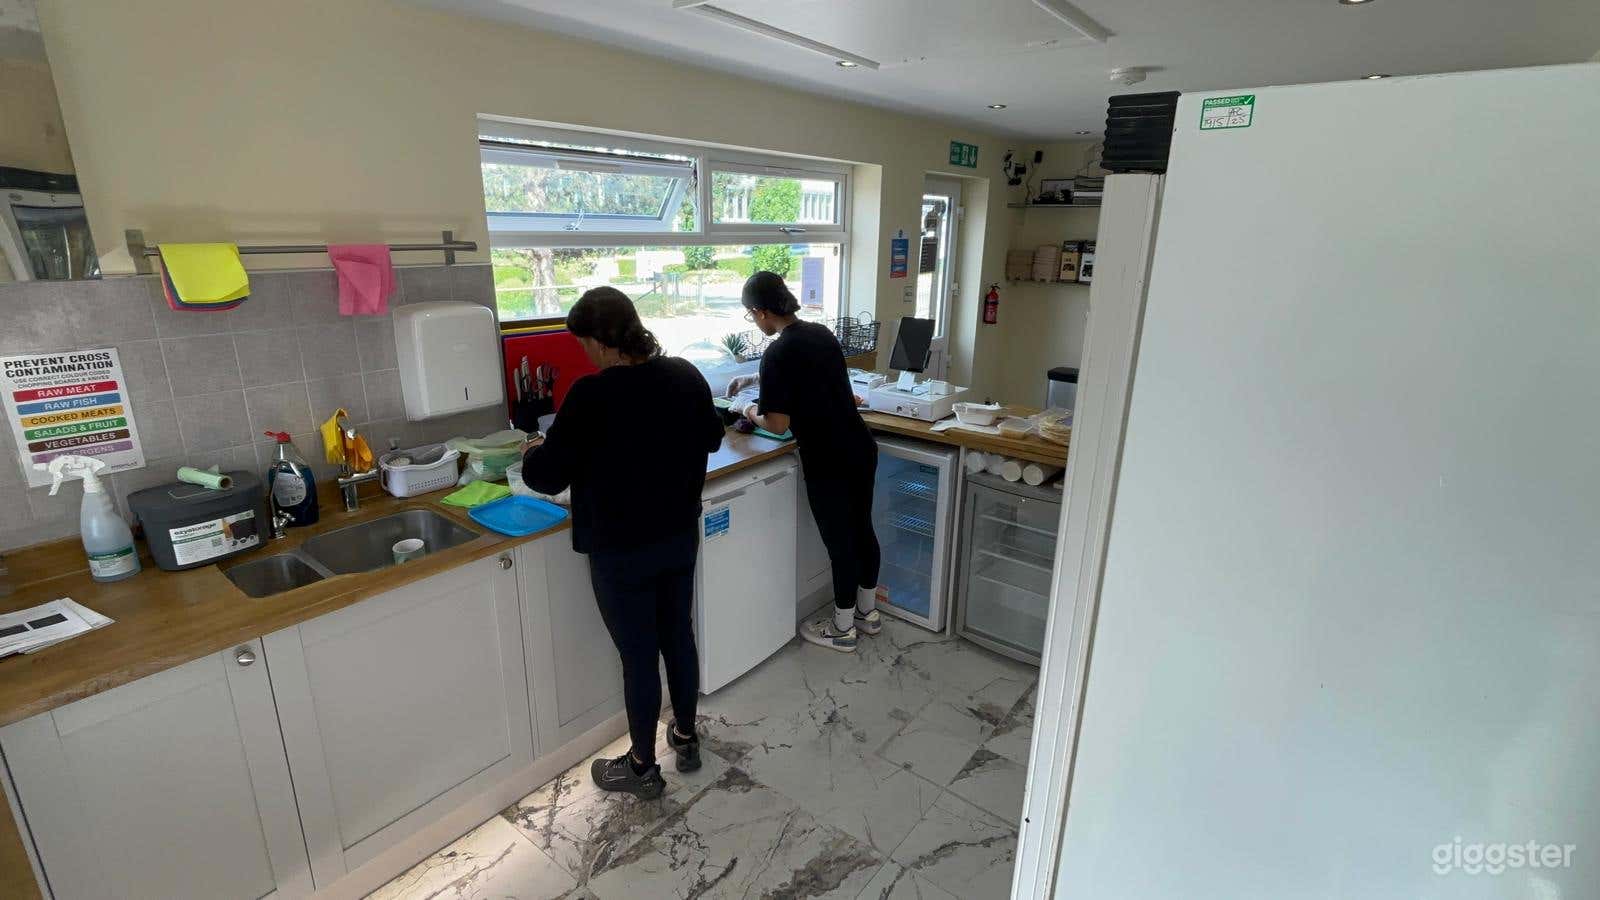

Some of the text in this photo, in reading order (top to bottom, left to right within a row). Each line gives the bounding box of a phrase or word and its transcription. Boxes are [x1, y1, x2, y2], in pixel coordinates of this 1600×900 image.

[1205, 98, 1231, 106] PASSED
[4, 352, 110, 369] PREVENT CROSS
[5, 361, 113, 378] CONTAMINATION
[18, 380, 53, 389] CHOPPING
[54, 378, 80, 386] BOARDS
[29, 374, 61, 382] CORRECT
[37, 385, 96, 397] RAW MEAT
[44, 397, 97, 411] RAW FISH
[31, 407, 117, 425] COOKED MEATS
[34, 420, 118, 438] SALADS & FRUIT
[45, 432, 116, 449] VEGETABLES
